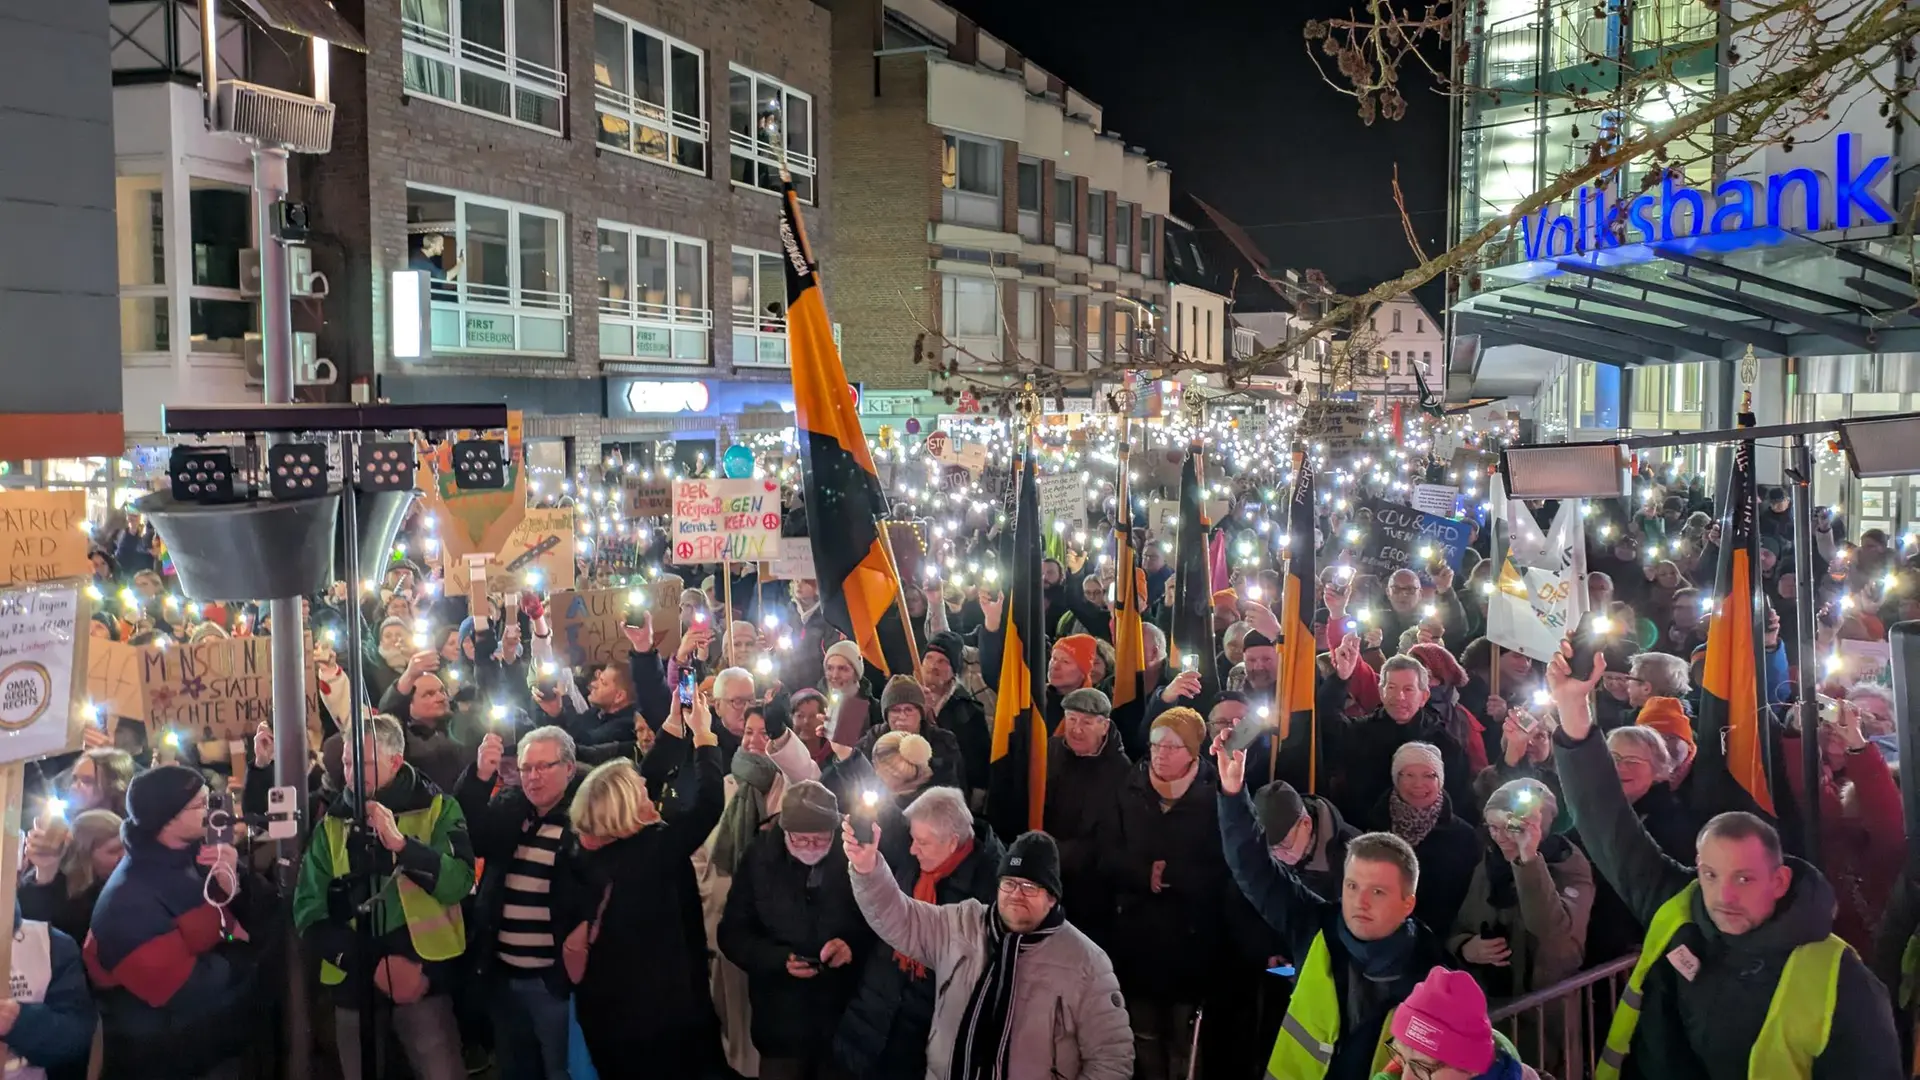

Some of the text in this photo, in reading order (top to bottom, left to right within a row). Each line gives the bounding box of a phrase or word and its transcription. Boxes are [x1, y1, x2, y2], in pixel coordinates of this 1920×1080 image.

[1520, 131, 1896, 262] Volksbank
[466, 318, 494, 330] FIRST
[637, 331, 656, 341] FIRST
[680, 482, 710, 499] DER
[1377, 509, 1410, 527] CDU
[1423, 521, 1459, 540] AFD
[12, 536, 57, 558] AFD
[695, 532, 768, 560] BRAUN
[9, 563, 61, 582] KEINE
[4, 687, 37, 701] GEGEN
[6, 679, 36, 691] OMAS
[209, 676, 263, 699] STATT
[2, 698, 39, 711] RECHTS
[151, 693, 317, 729] RECHTE MENN
